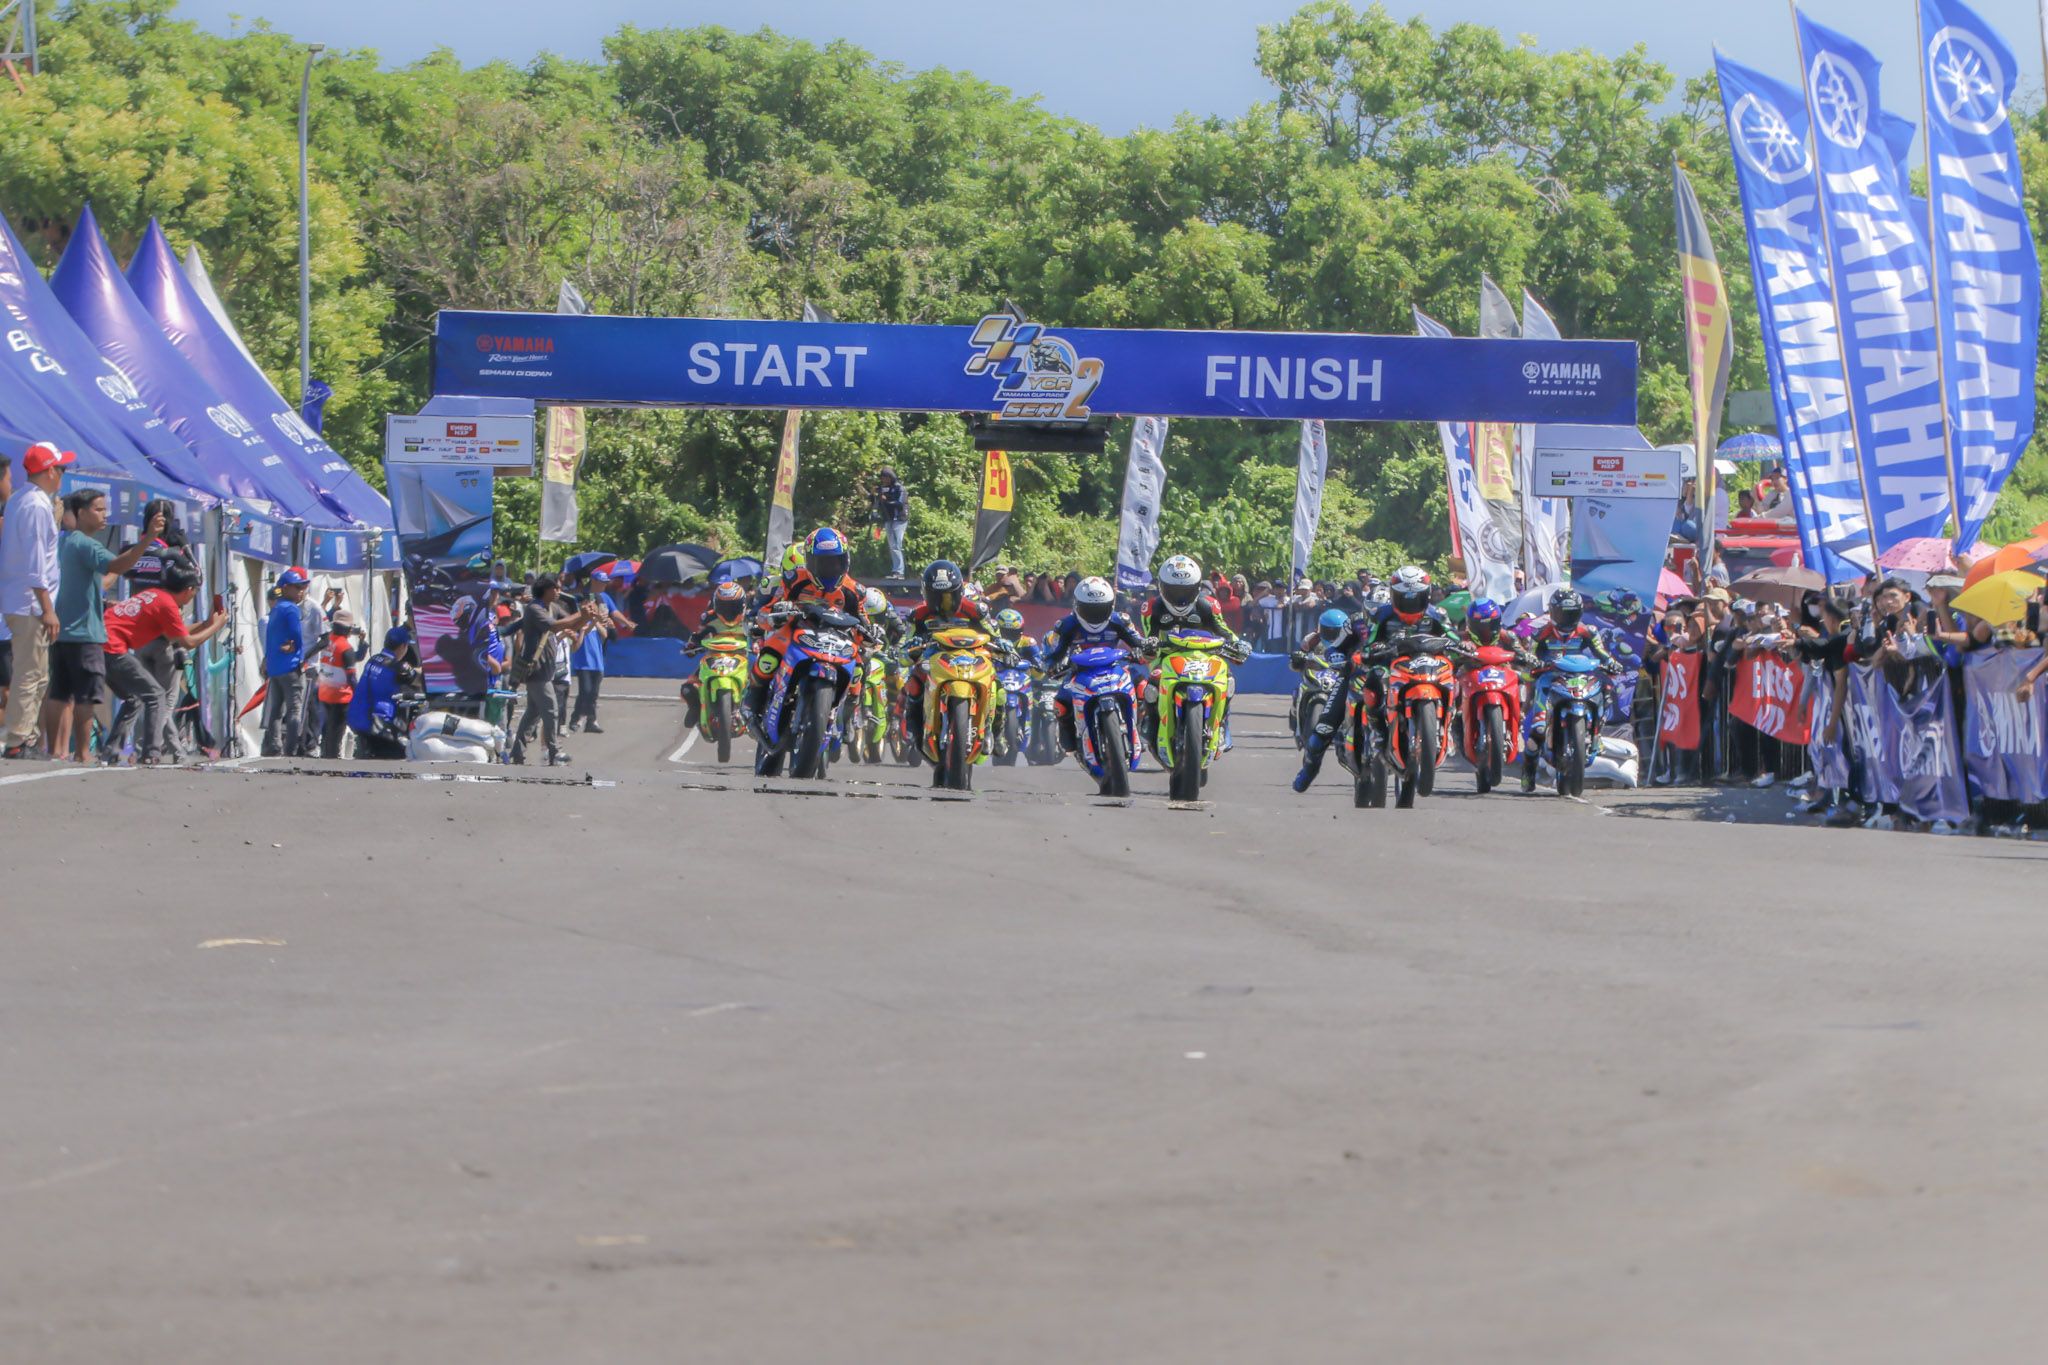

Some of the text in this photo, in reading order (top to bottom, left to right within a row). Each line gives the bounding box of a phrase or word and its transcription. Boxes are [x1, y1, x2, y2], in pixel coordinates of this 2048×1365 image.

[495, 336, 555, 352] YAMAHA
[1826, 164, 1951, 533] YAMAHA
[1938, 152, 2021, 521] YAMAHA
[687, 342, 868, 388] START
[1002, 358, 1104, 418] SERI 2
[1028, 376, 1073, 390] YCR
[1205, 355, 1383, 402] FINISH
[1540, 363, 1602, 379] YAMAHA
[1754, 194, 1868, 547] YAMAHA
